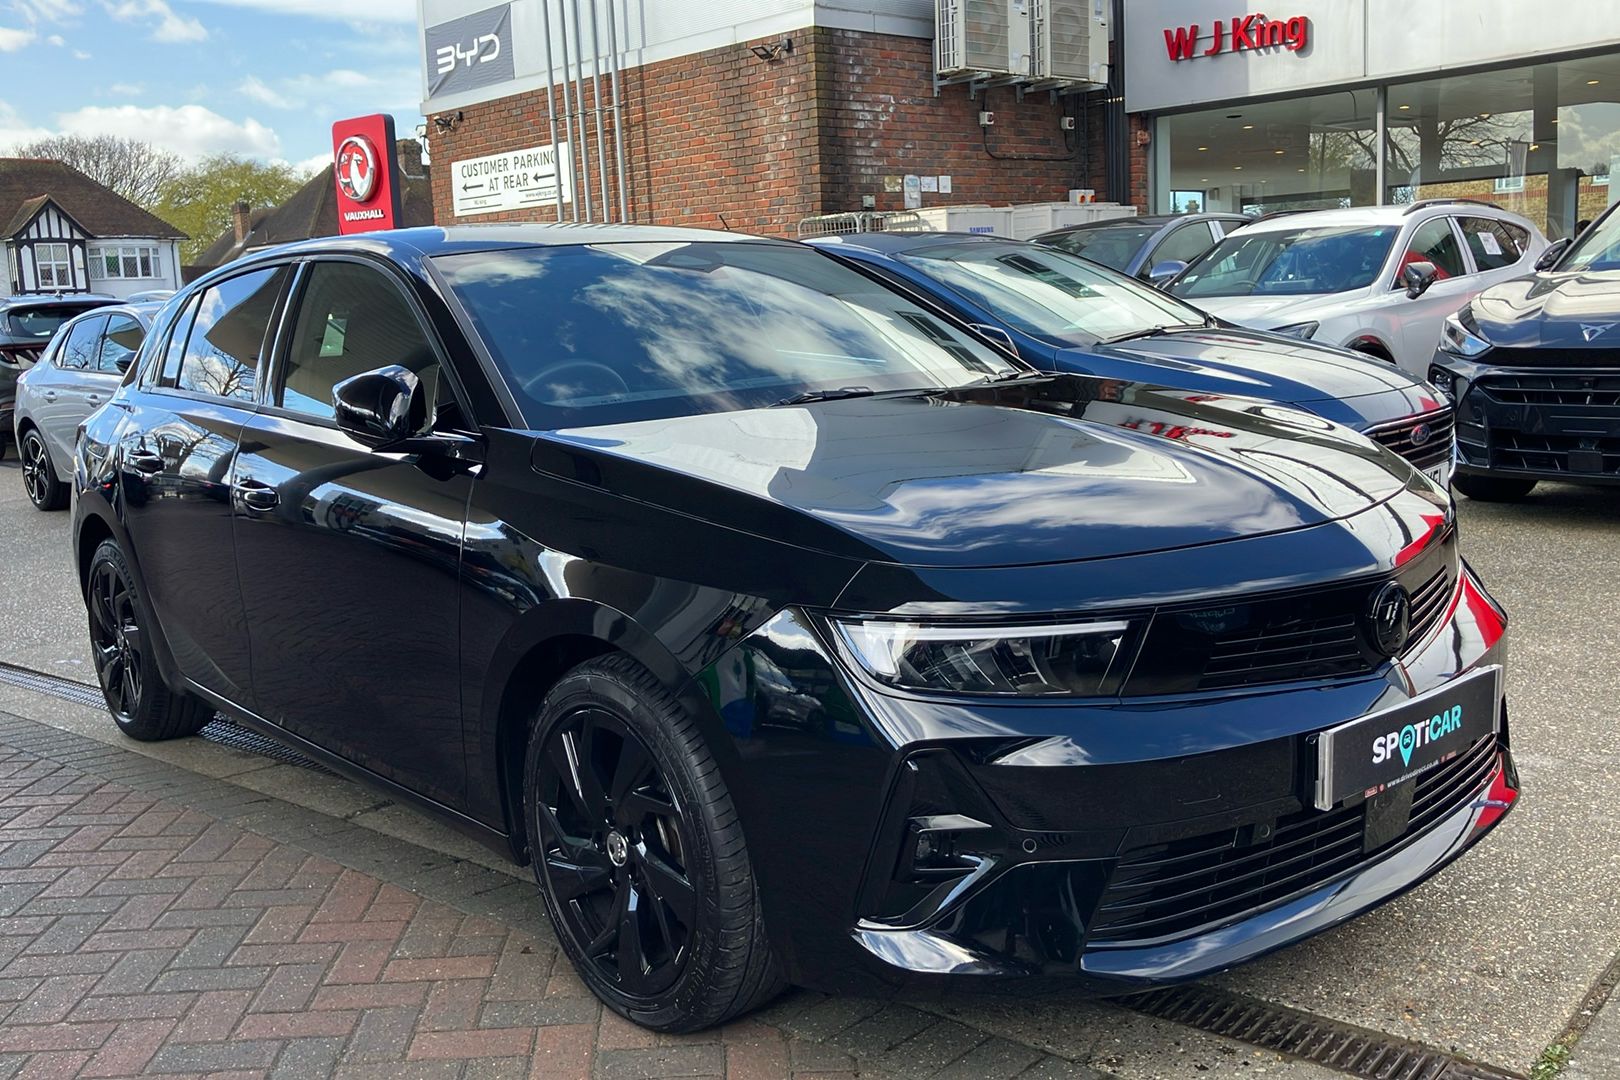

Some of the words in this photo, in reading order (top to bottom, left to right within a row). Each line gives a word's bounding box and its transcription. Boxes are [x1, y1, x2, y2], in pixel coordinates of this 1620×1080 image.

[1163, 25, 1199, 61] W
[1204, 20, 1223, 56] J
[1232, 13, 1308, 52] King
[436, 33, 500, 75] BYD
[461, 157, 509, 179] CUSTOMER
[488, 176, 500, 192] AT
[503, 172, 529, 190] REAR
[343, 209, 385, 221] VAUXHALL
